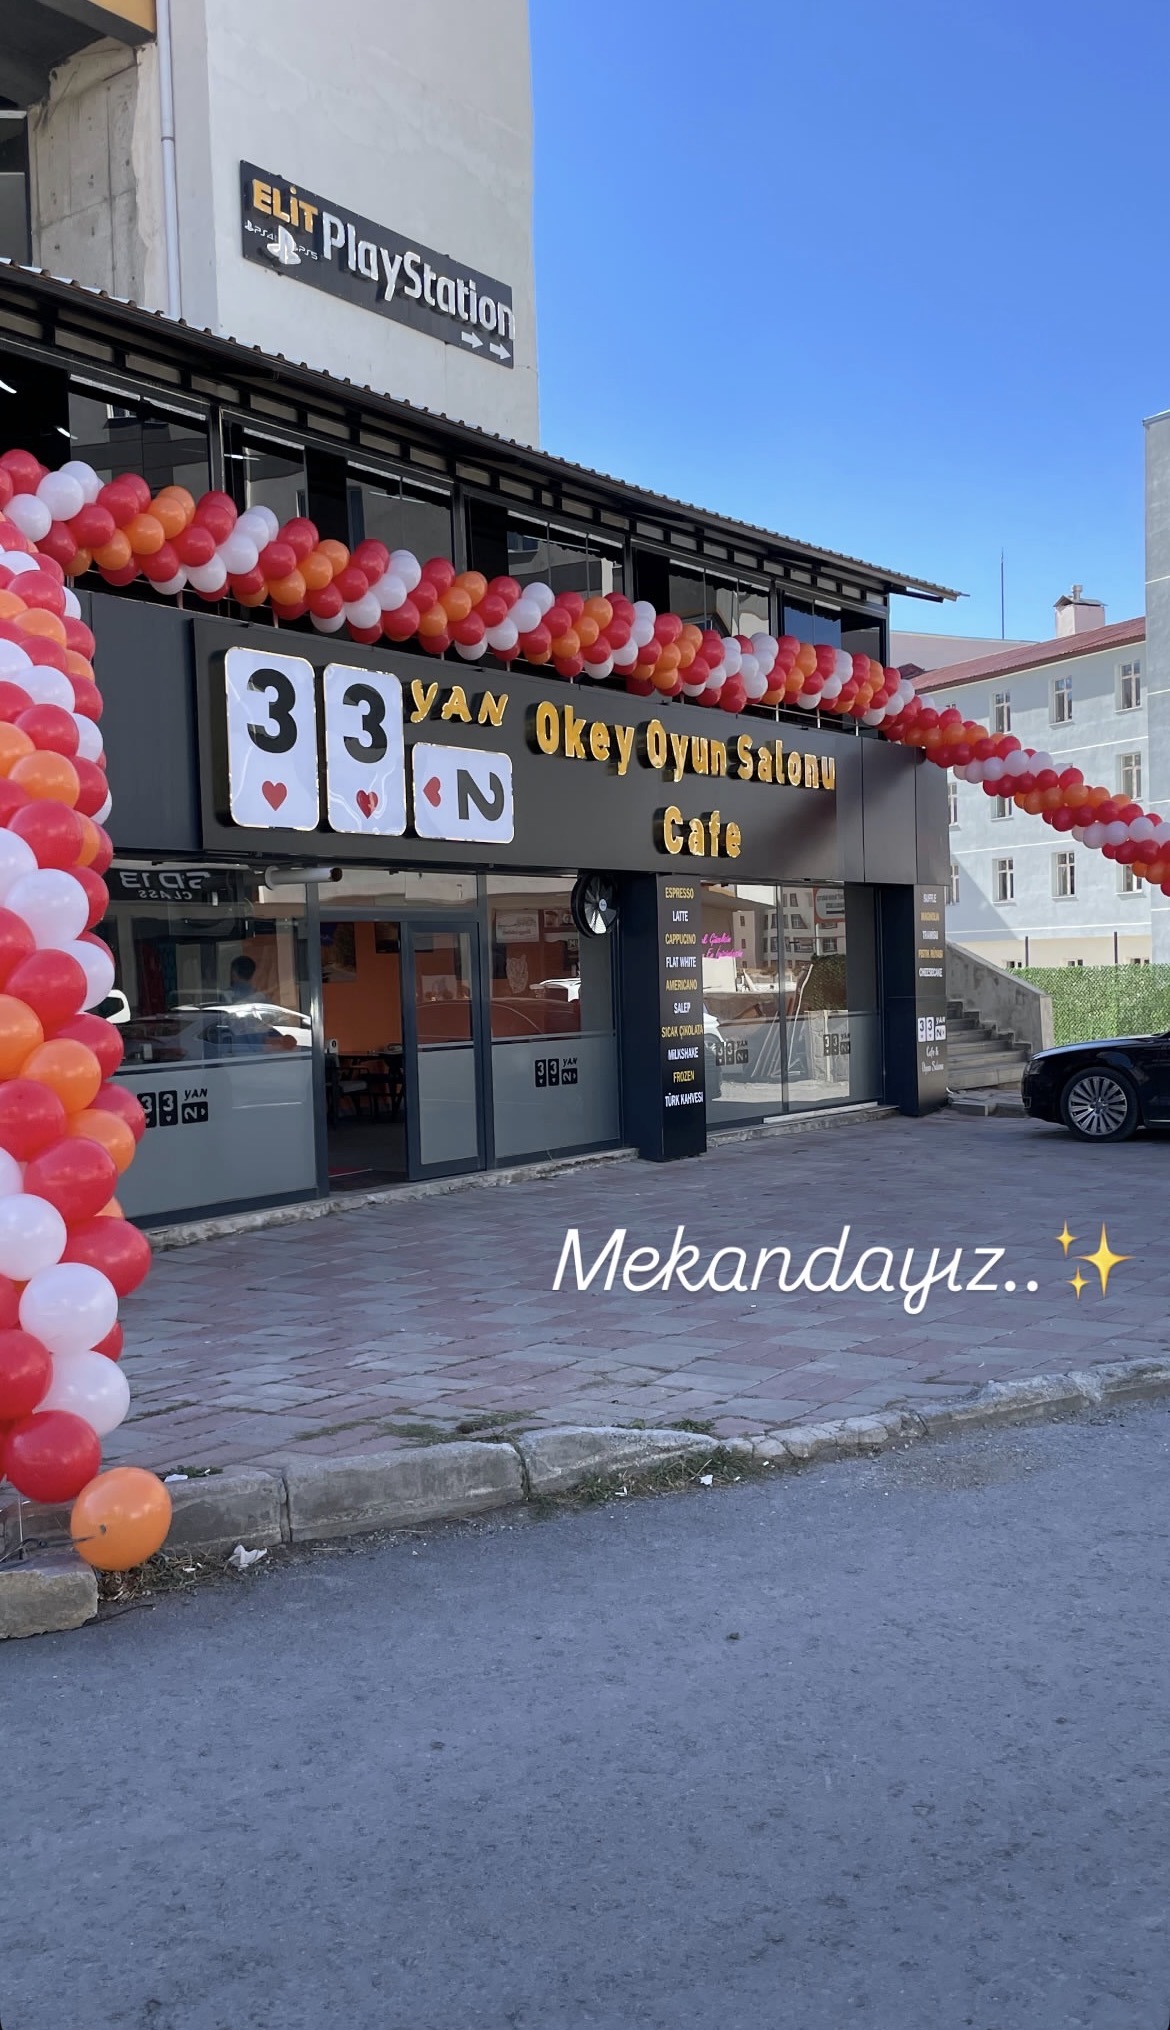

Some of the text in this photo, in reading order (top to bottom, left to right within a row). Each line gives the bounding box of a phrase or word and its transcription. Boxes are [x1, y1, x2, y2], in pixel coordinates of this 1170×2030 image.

[298, 245, 318, 260] PS5
[322, 211, 516, 340] PlayStation
[535, 701, 835, 790] Okey Oyun Salonu
[663, 805, 742, 859] Cafe
[665, 887, 694, 899] ESPRESSO
[672, 910, 688, 922] LATTE
[666, 956, 697, 968] FLAT WHITE
[673, 1002, 691, 1014] SALEP
[673, 1070, 695, 1083] FROZEN
[664, 1092, 680, 1107] TÜRK
